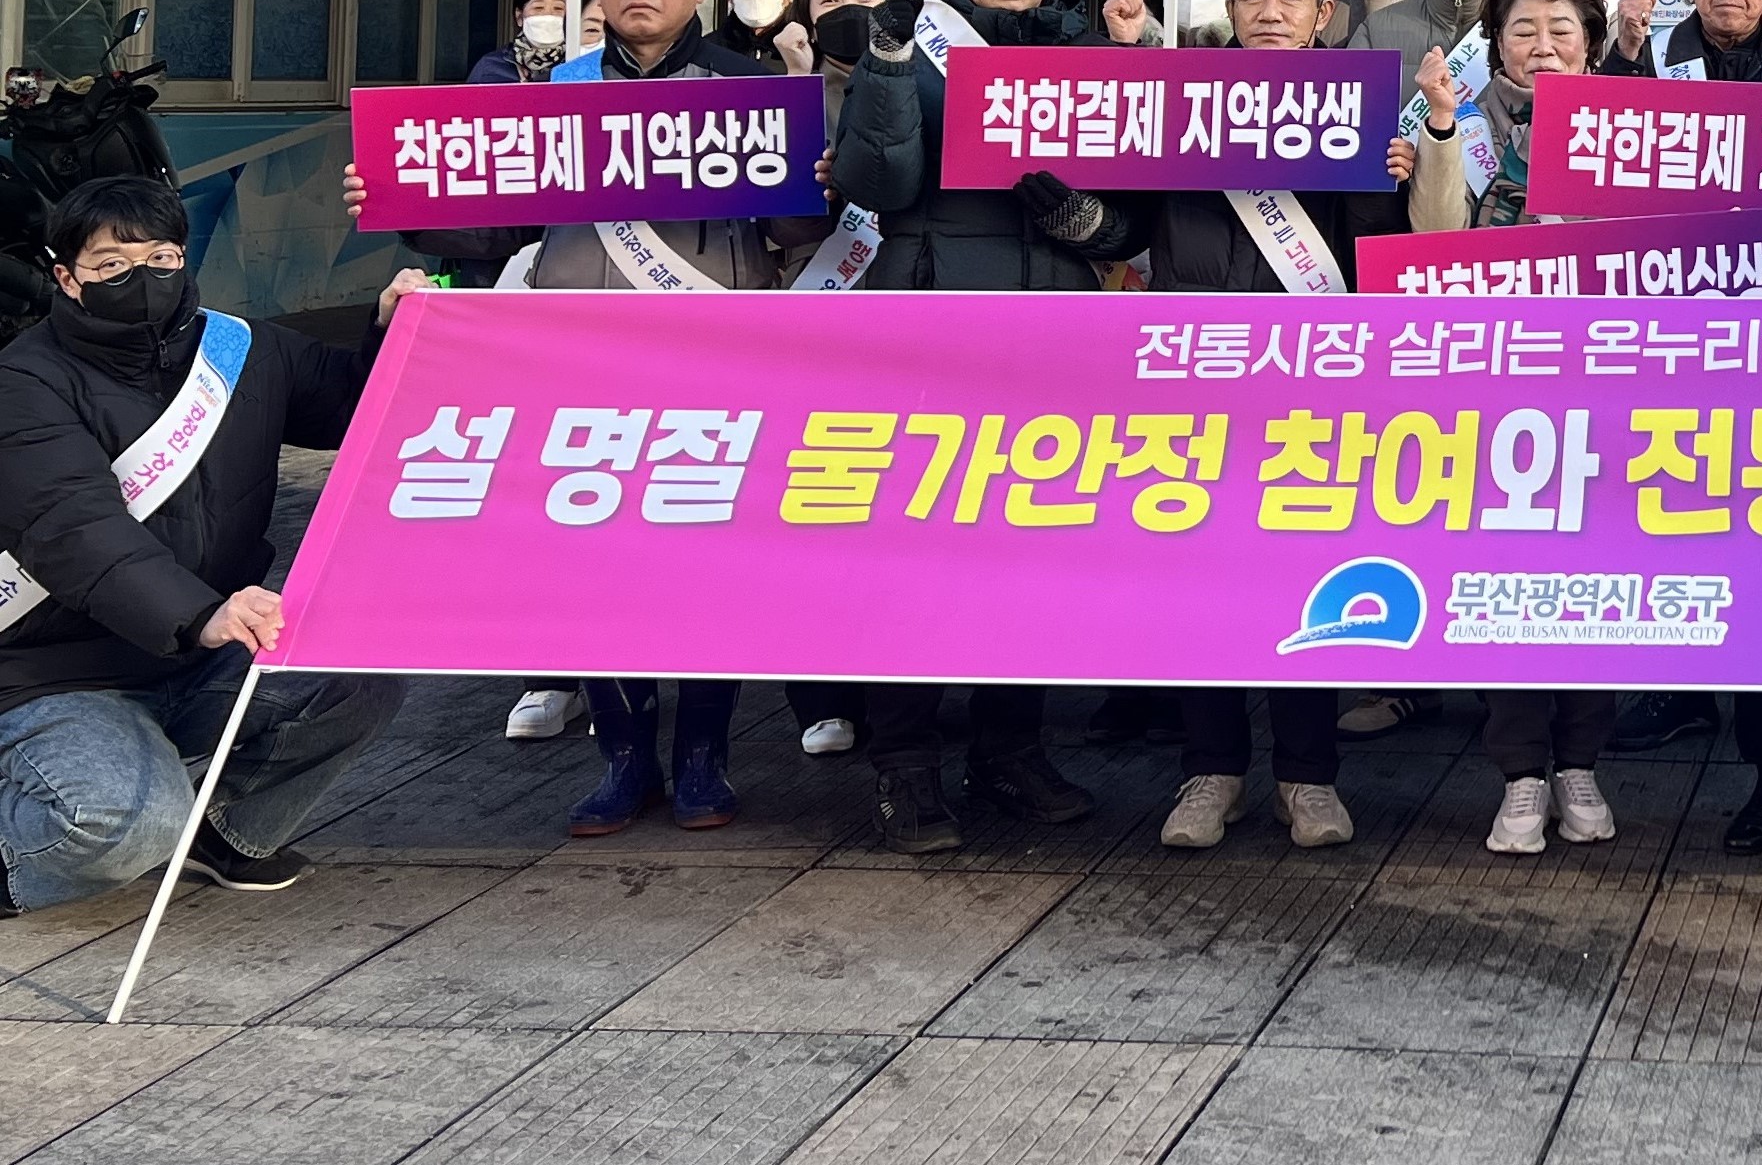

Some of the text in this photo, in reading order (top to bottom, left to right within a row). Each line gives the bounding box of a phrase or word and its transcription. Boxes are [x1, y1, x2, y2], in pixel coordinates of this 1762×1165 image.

[394, 107, 788, 197] 착한결제 지역상생
[982, 77, 1363, 161] 착한결제 지역상생
[1567, 106, 1743, 193] 착한결제
[614, 221, 655, 267] 안정과
[1133, 322, 1375, 380] 전통시장
[1388, 320, 1565, 377] 살리는
[386, 404, 515, 522] 설
[538, 406, 764, 526] 명절
[777, 409, 1231, 533] 물가안정
[1254, 406, 1599, 535] 참여와
[1449, 623, 1723, 641] JUNG-GU BUSAN METROPOLITAN CITY
[1451, 576, 1728, 620] 부산광역시 중구
